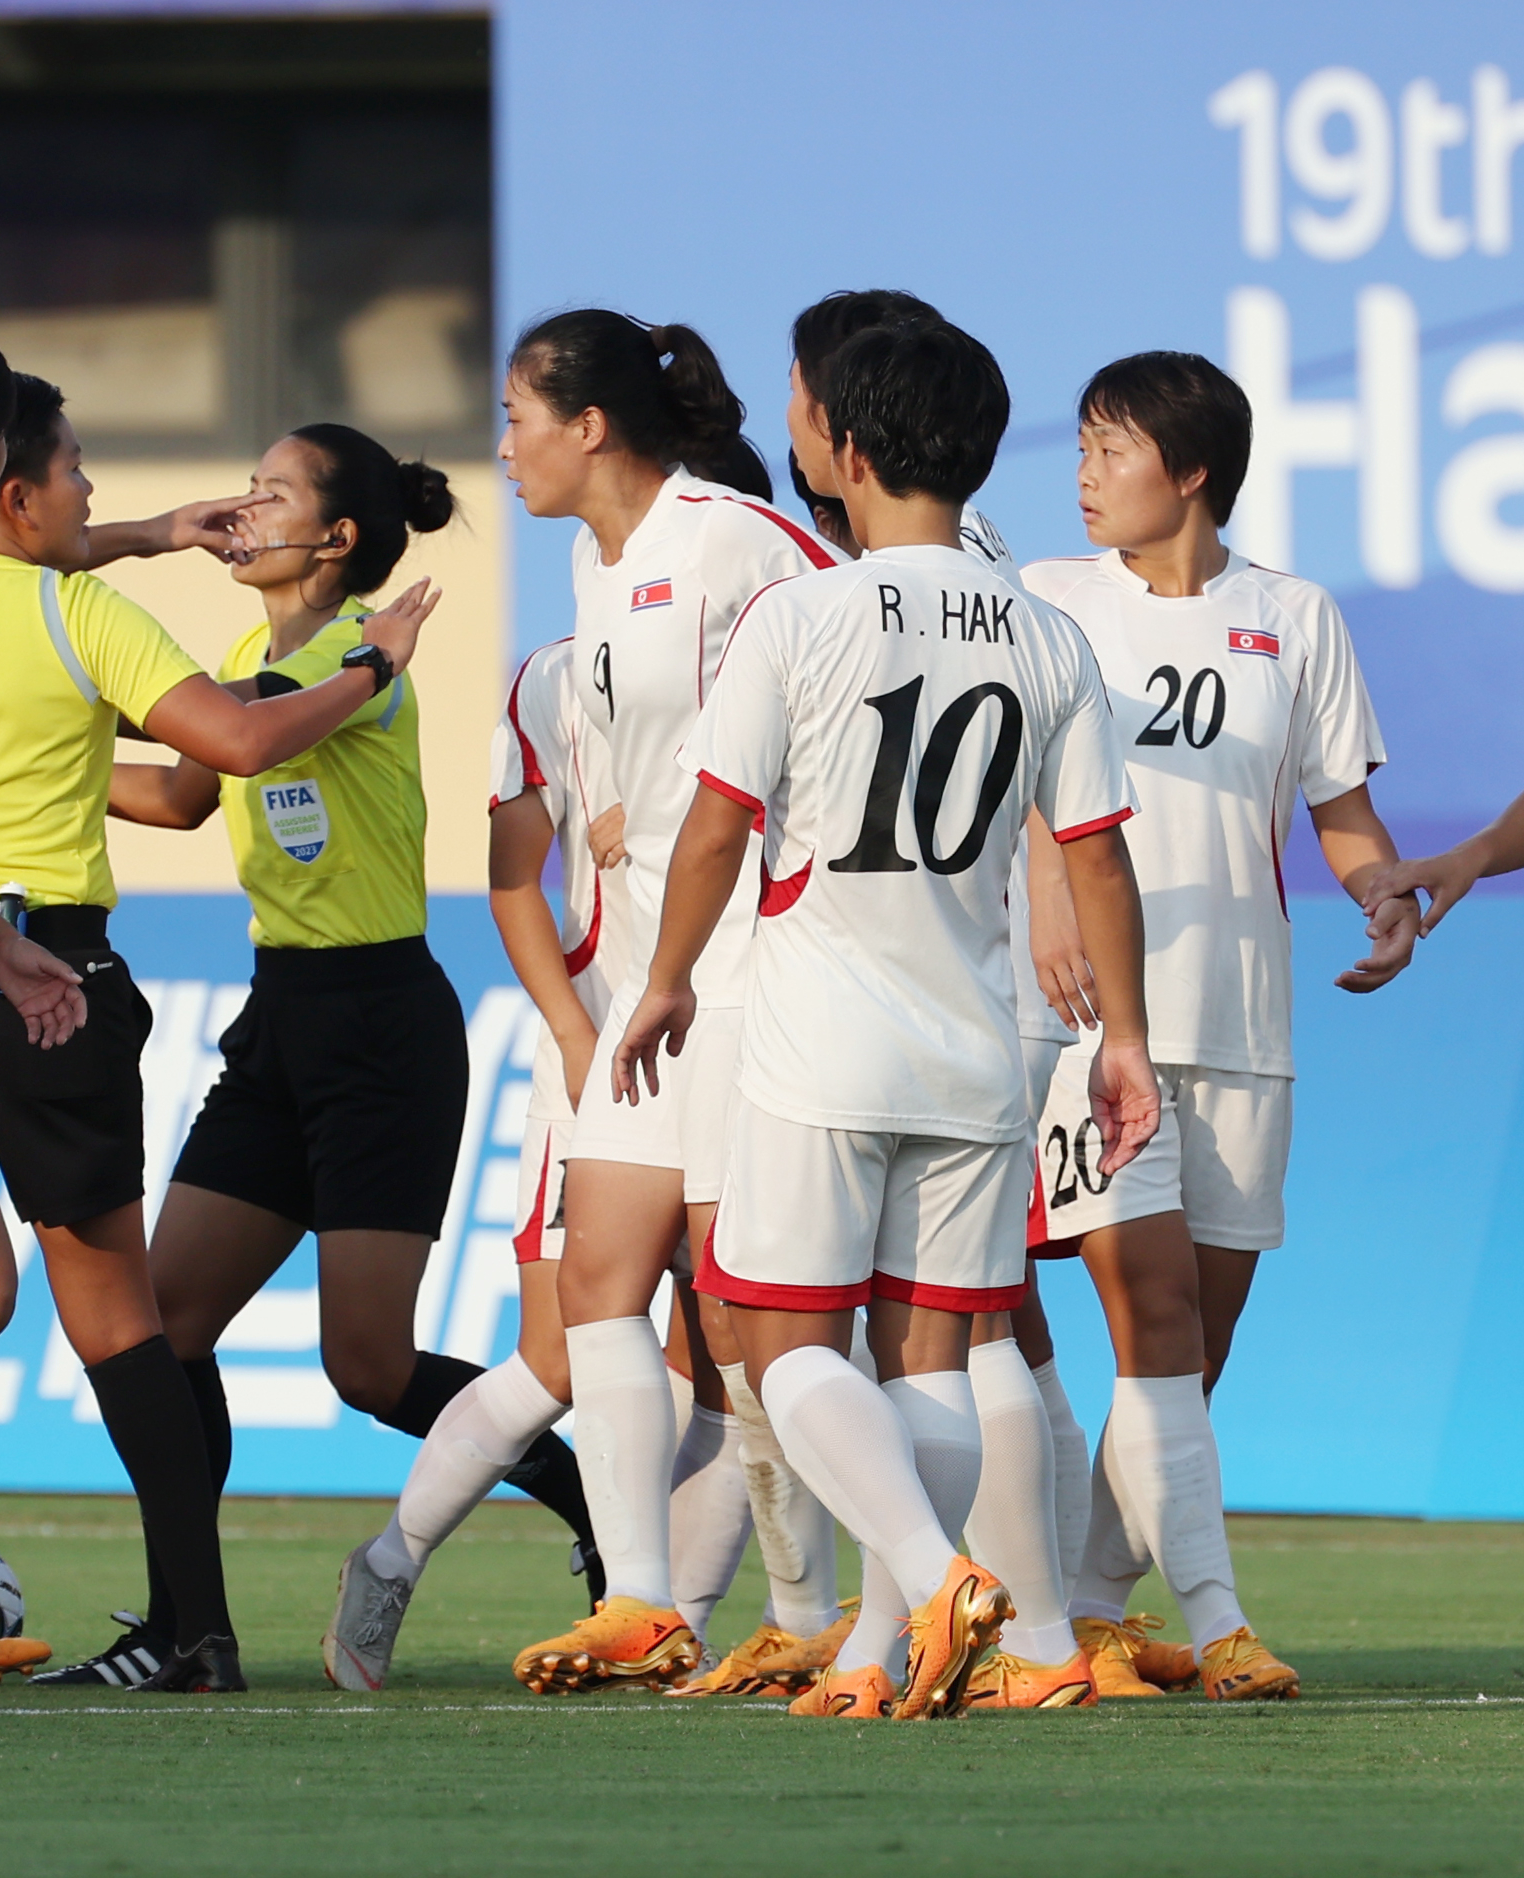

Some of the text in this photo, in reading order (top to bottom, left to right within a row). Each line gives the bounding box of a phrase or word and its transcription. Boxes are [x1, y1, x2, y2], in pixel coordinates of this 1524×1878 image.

[1225, 282, 1524, 594] Ha
[941, 589, 1014, 646] HAK
[593, 641, 614, 724] 9
[1135, 664, 1226, 749] 20
[266, 786, 316, 810] FIFA
[827, 674, 1023, 876] 10
[295, 845, 318, 857] 2023
[1045, 1117, 1114, 1210] 20
